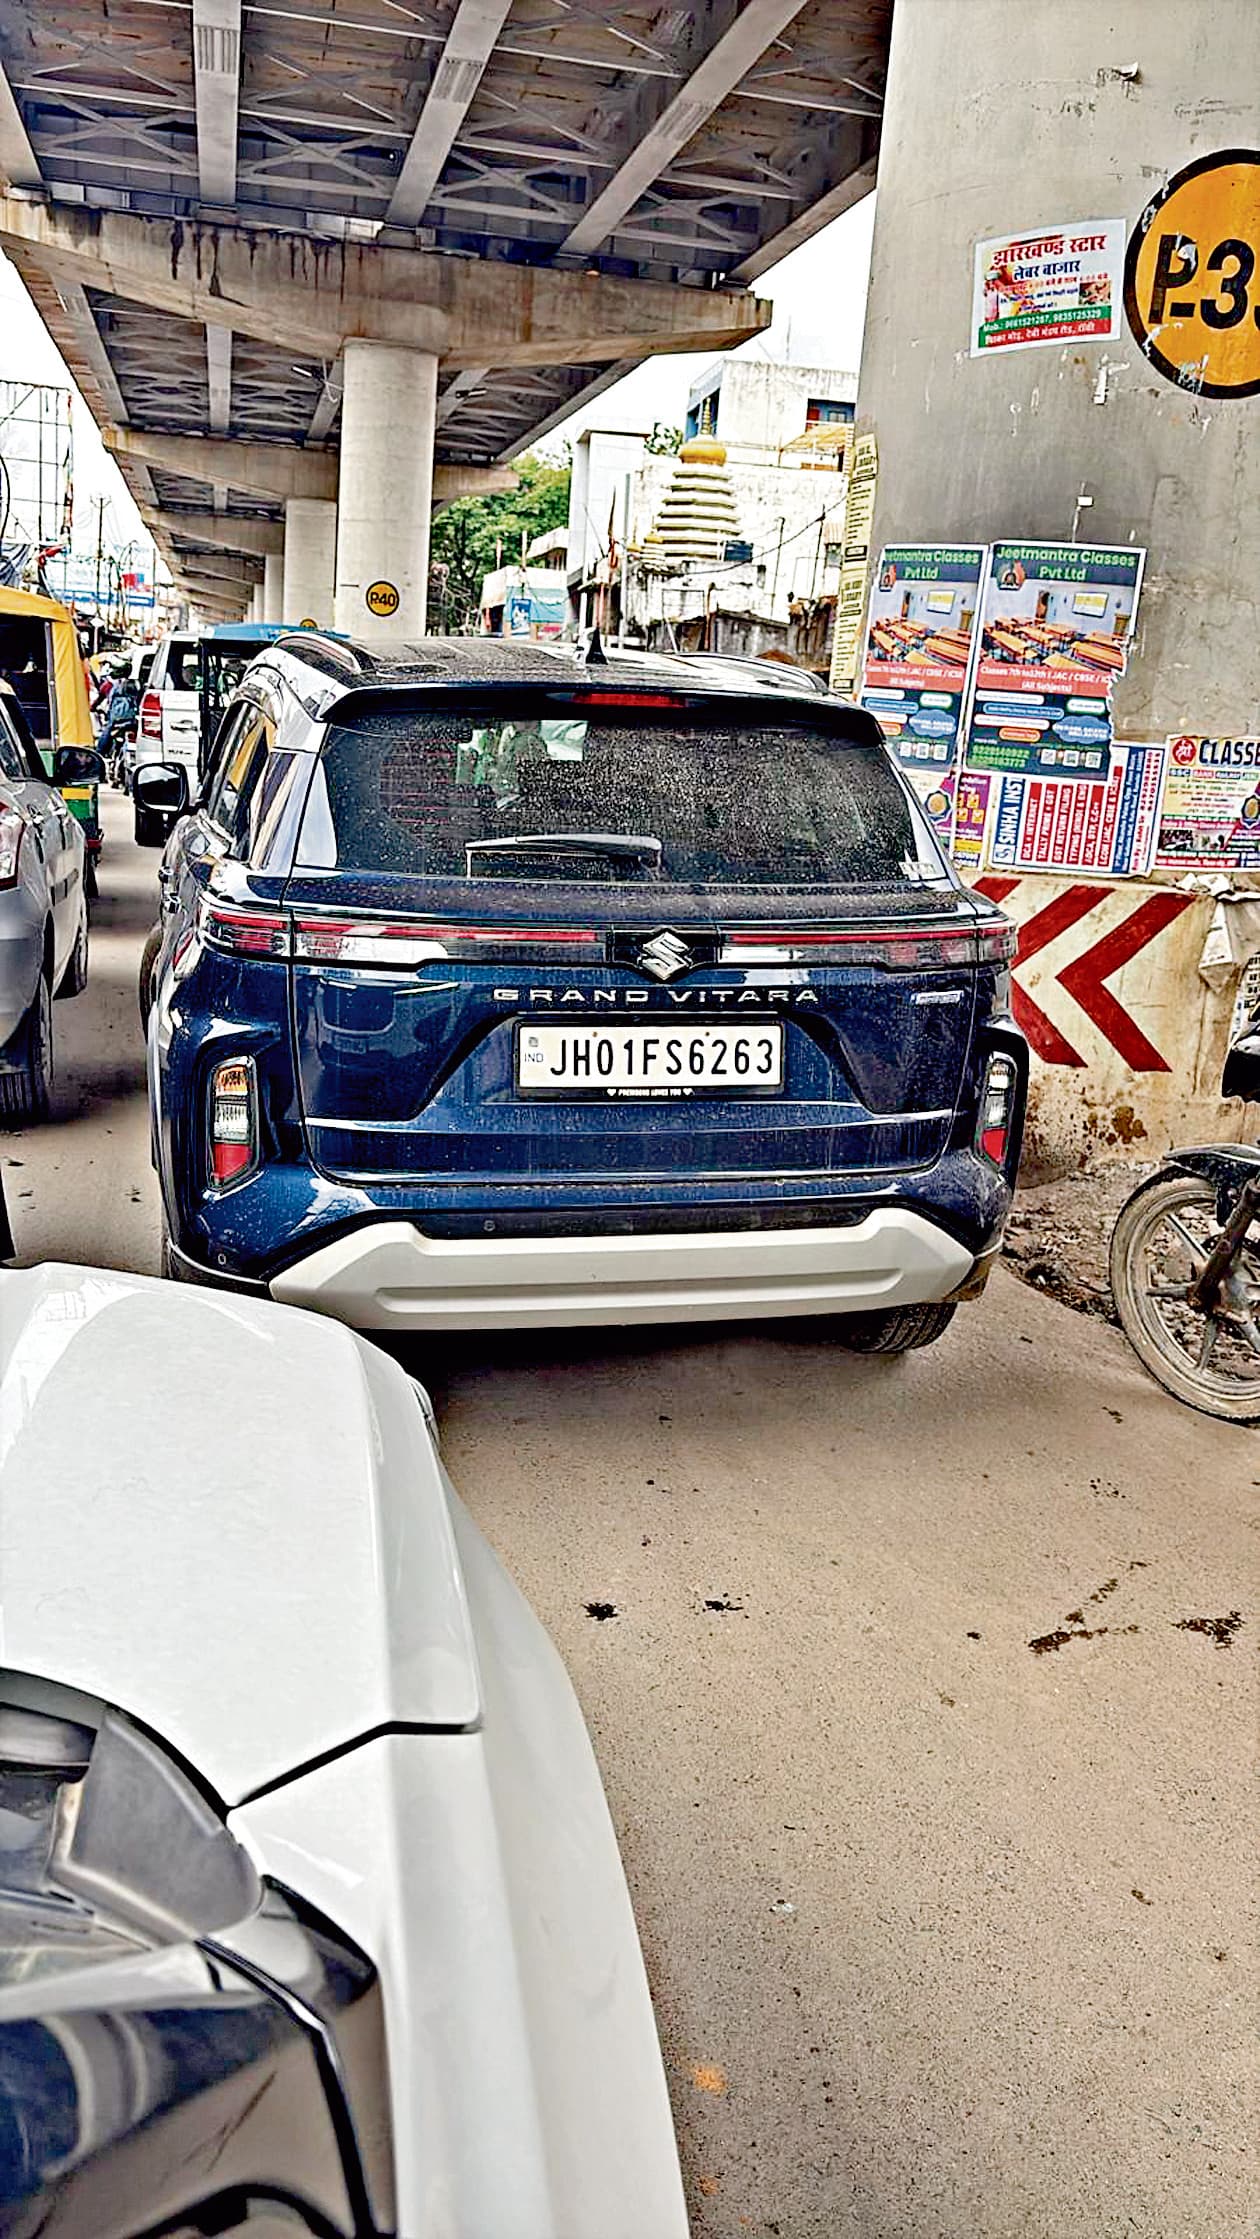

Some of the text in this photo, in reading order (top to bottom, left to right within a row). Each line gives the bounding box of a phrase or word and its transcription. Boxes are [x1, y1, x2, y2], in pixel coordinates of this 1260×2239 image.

[1070, 235, 1107, 252] स्टार
[1148, 234, 1260, 330] P-3
[933, 551, 979, 564] Classes
[997, 546, 1136, 566] Jeetmantra Classes
[904, 566, 938, 579] Pvt Ltd
[1039, 566, 1087, 580] Pvt Ltd
[998, 806, 1020, 845] SINHA
[492, 987, 820, 1003] GRAND VITARA
[524, 1052, 544, 1064] IND
[549, 1038, 774, 1076] JH01FS6263
